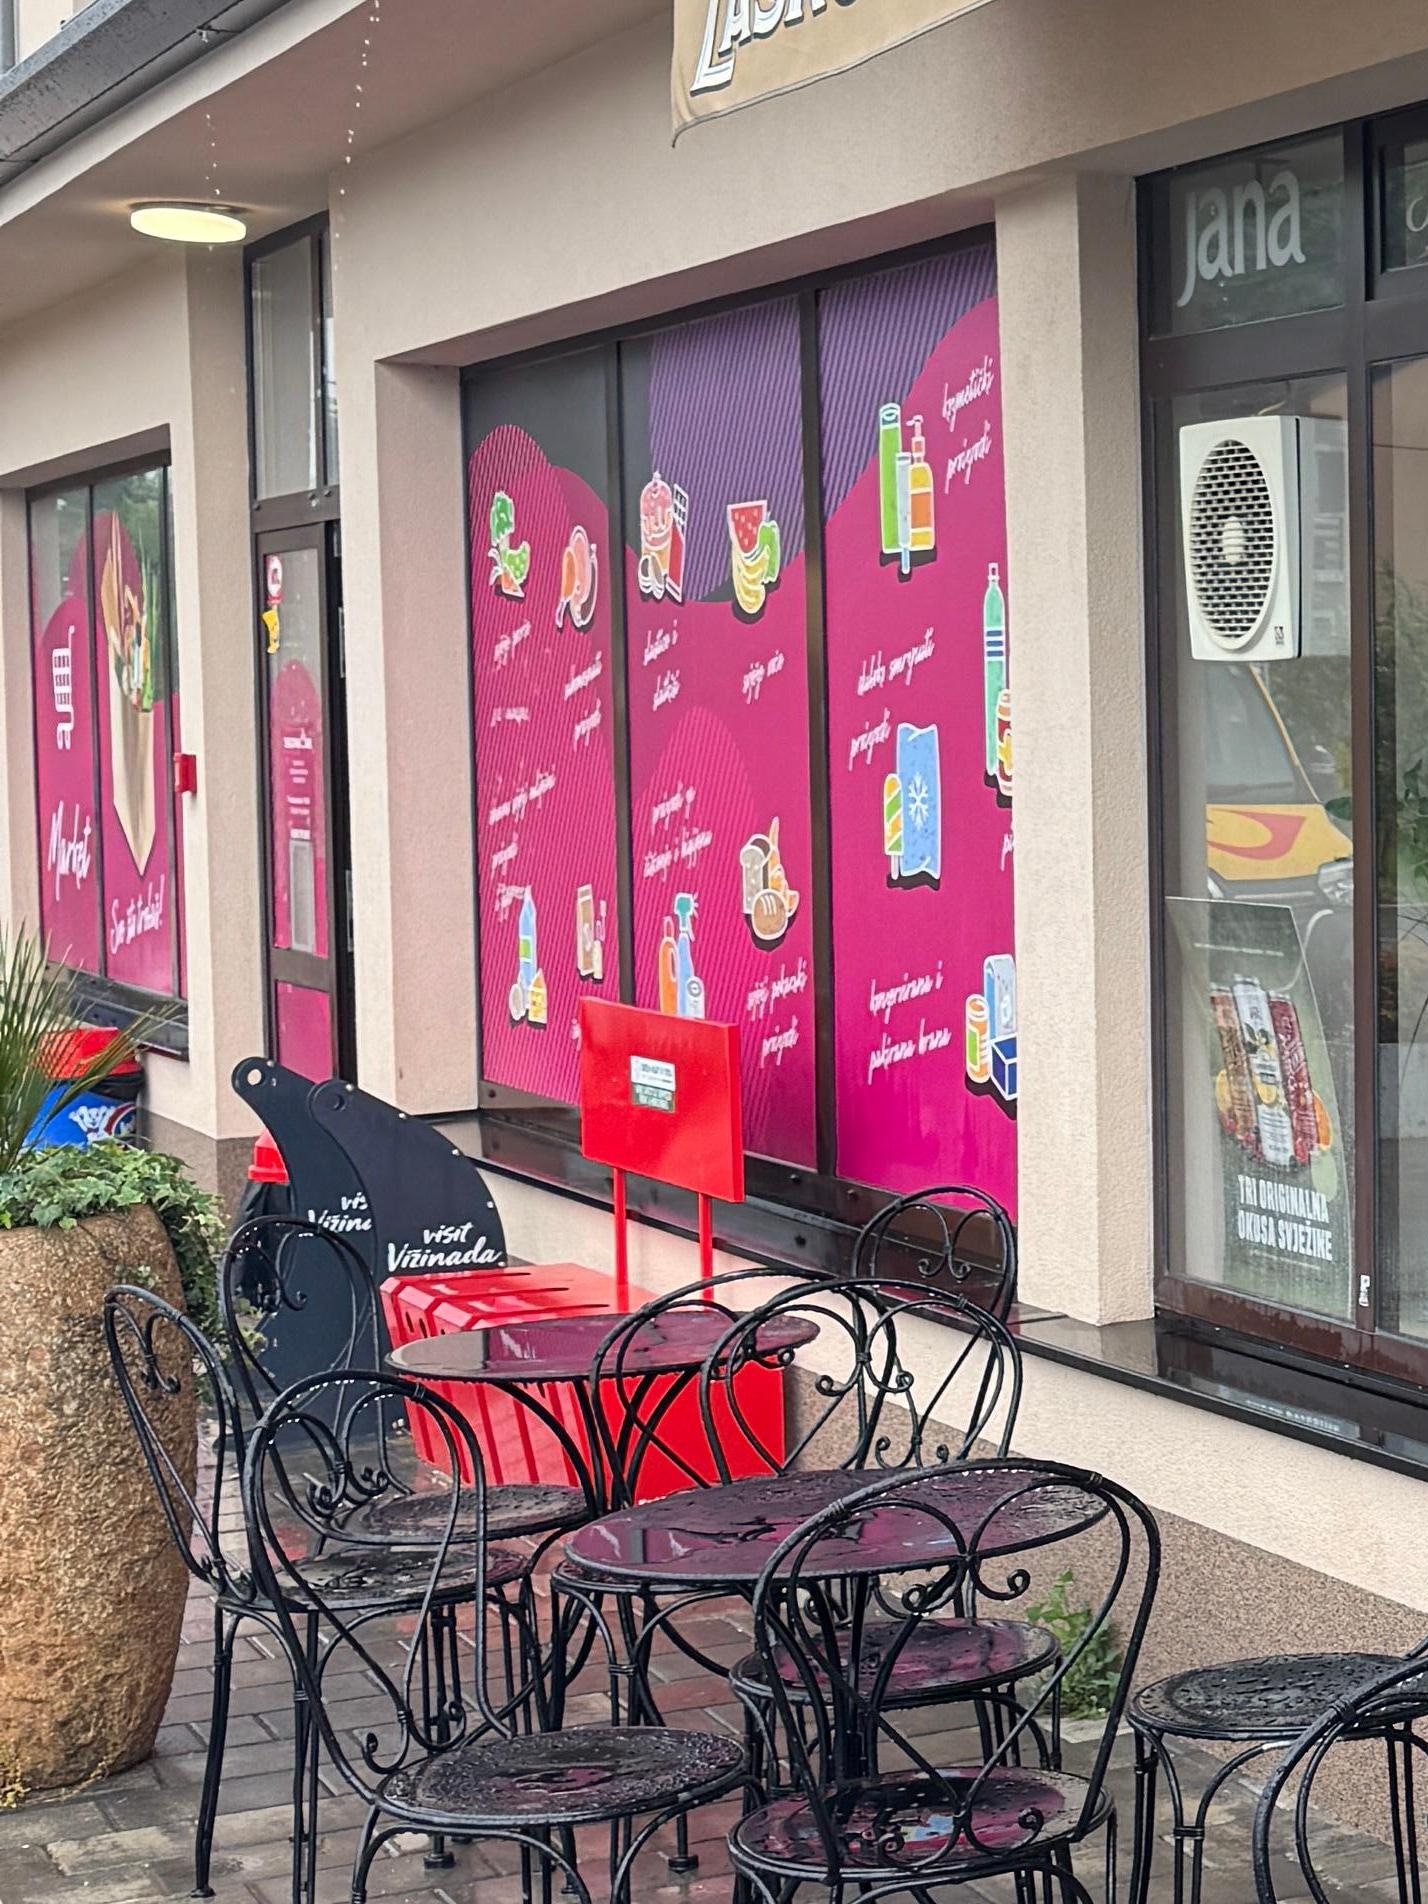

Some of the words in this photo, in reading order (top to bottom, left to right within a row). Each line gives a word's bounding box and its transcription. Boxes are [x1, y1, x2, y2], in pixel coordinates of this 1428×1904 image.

[341, 1192, 367, 1210] vis
[1237, 1174, 1258, 1206] TRI
[423, 1222, 473, 1244] visit
